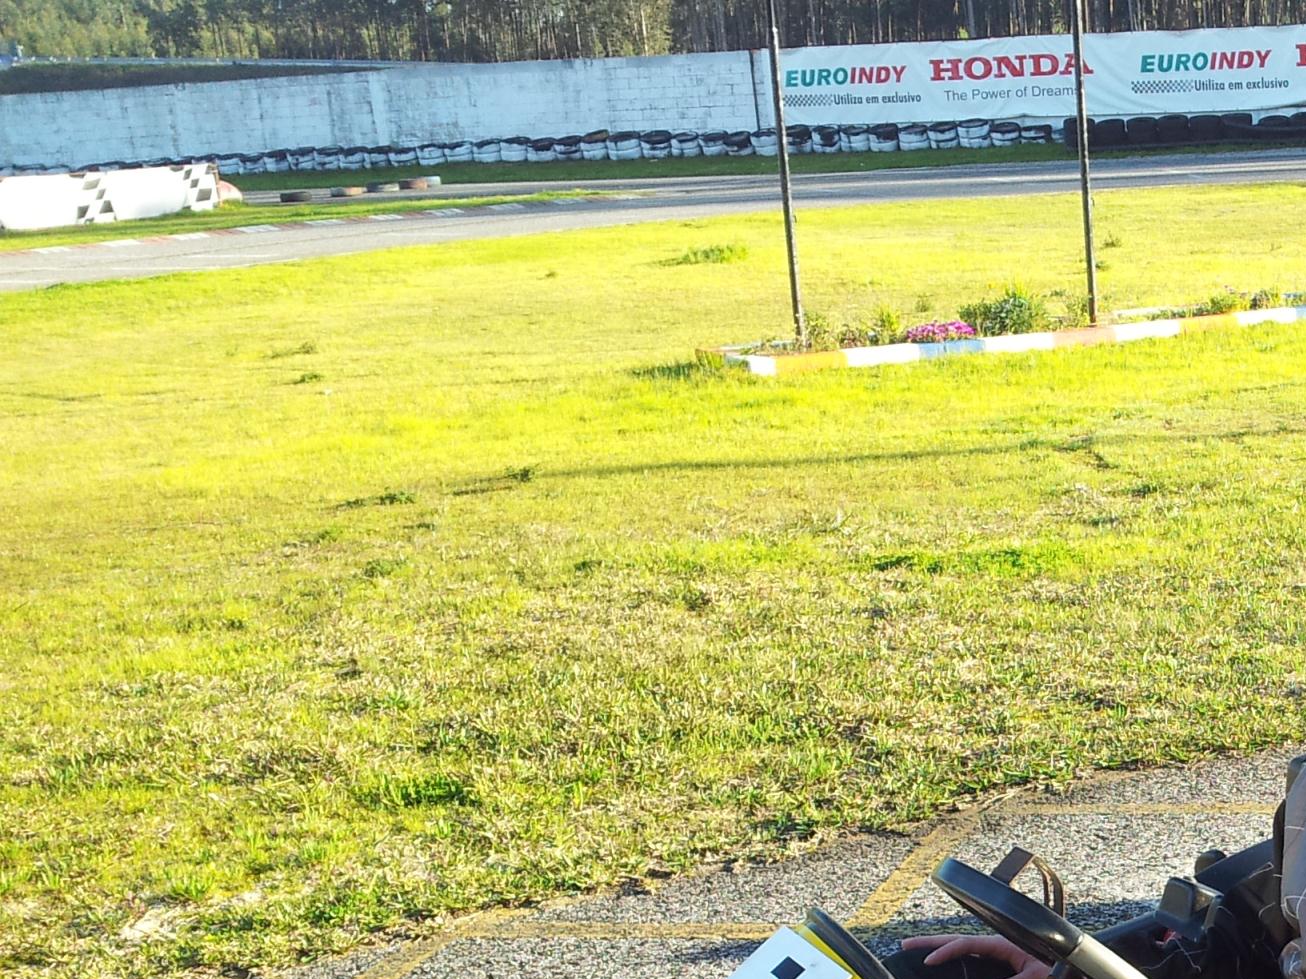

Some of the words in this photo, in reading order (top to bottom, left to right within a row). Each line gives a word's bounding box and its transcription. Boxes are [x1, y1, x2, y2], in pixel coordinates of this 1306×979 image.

[928, 53, 1094, 82] HONDA
[1140, 49, 1272, 73] EUROINDY
[785, 65, 907, 87] EUROINDY
[1194, 79, 1225, 92] Utiliza
[1228, 81, 1243, 90] em
[1246, 77, 1289, 89] exclusivo
[833, 93, 863, 105] Utiliza
[866, 95, 879, 104] em
[881, 91, 922, 104] exclusivo
[944, 90, 967, 101] The
[972, 88, 1011, 100] Power
[1015, 86, 1028, 98] of
